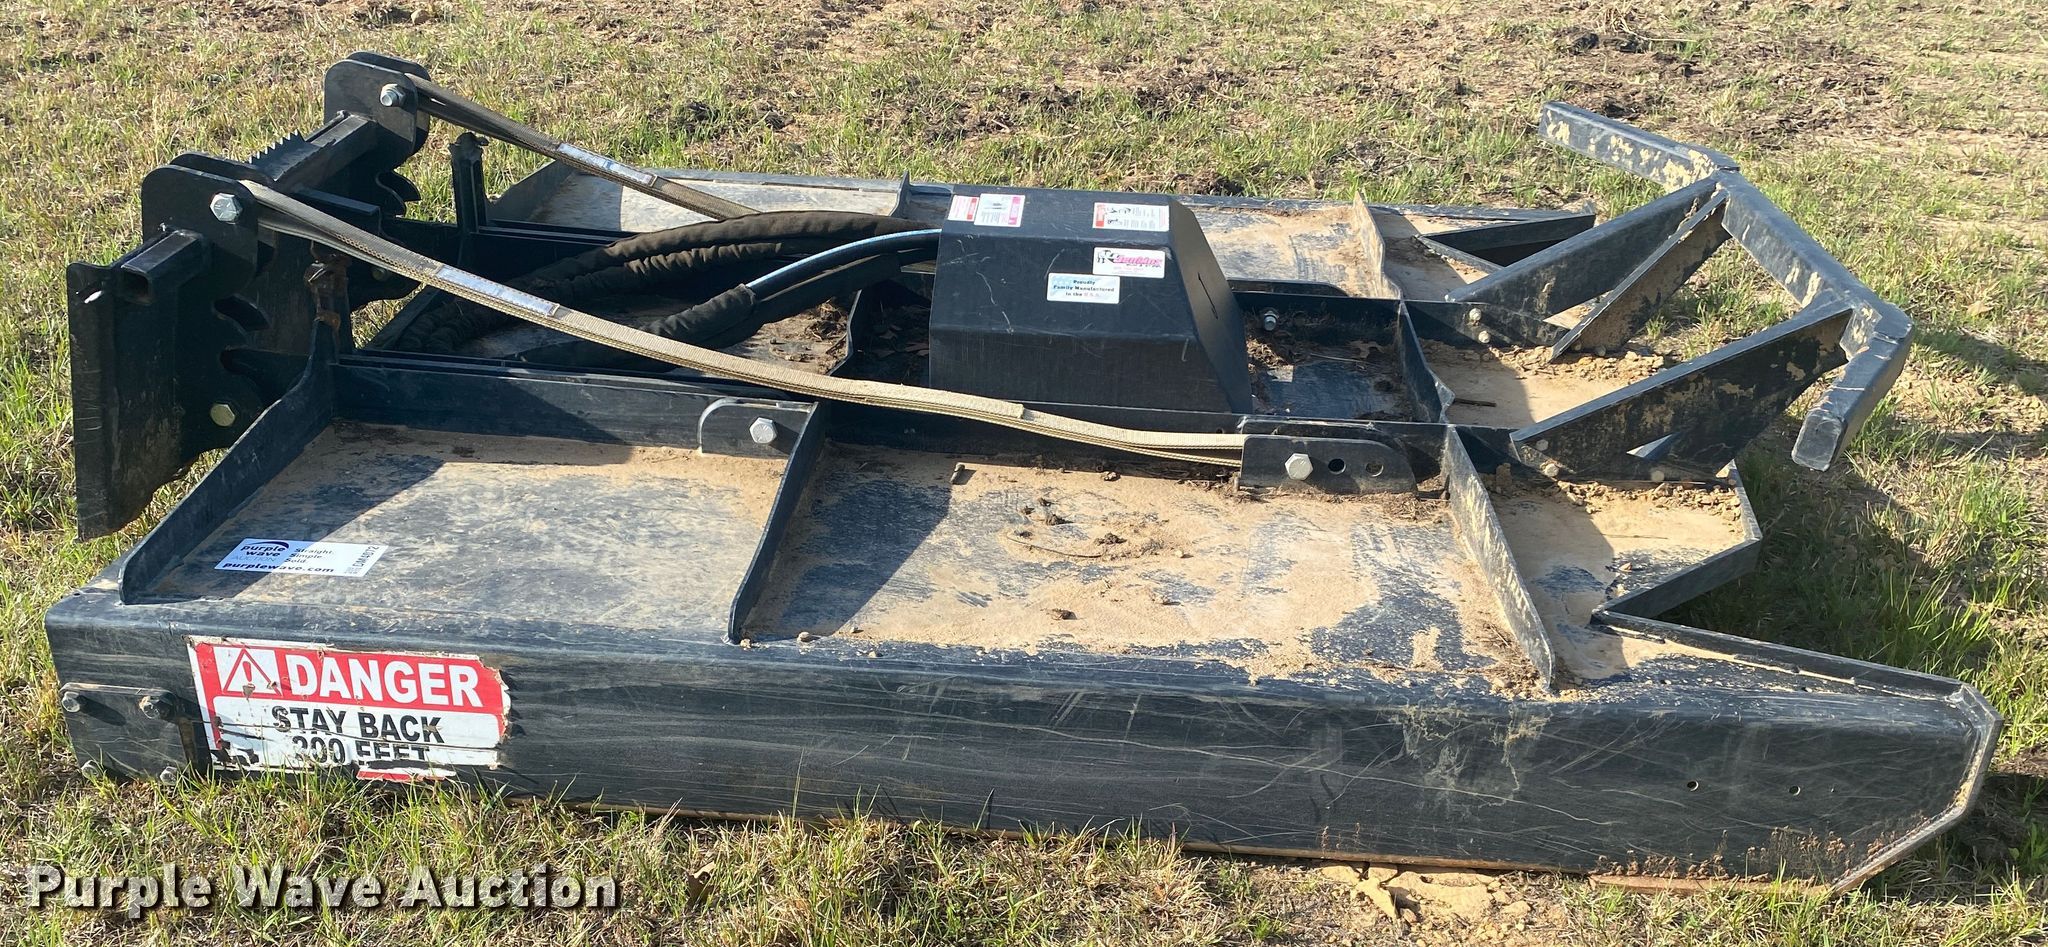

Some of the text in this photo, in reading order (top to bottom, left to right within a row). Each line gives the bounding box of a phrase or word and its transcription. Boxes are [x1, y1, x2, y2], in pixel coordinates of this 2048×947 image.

[241, 544, 286, 553] purple
[223, 562, 334, 573] purplewave.com
[285, 655, 484, 707] DANGER
[271, 706, 445, 743] STAY BACK
